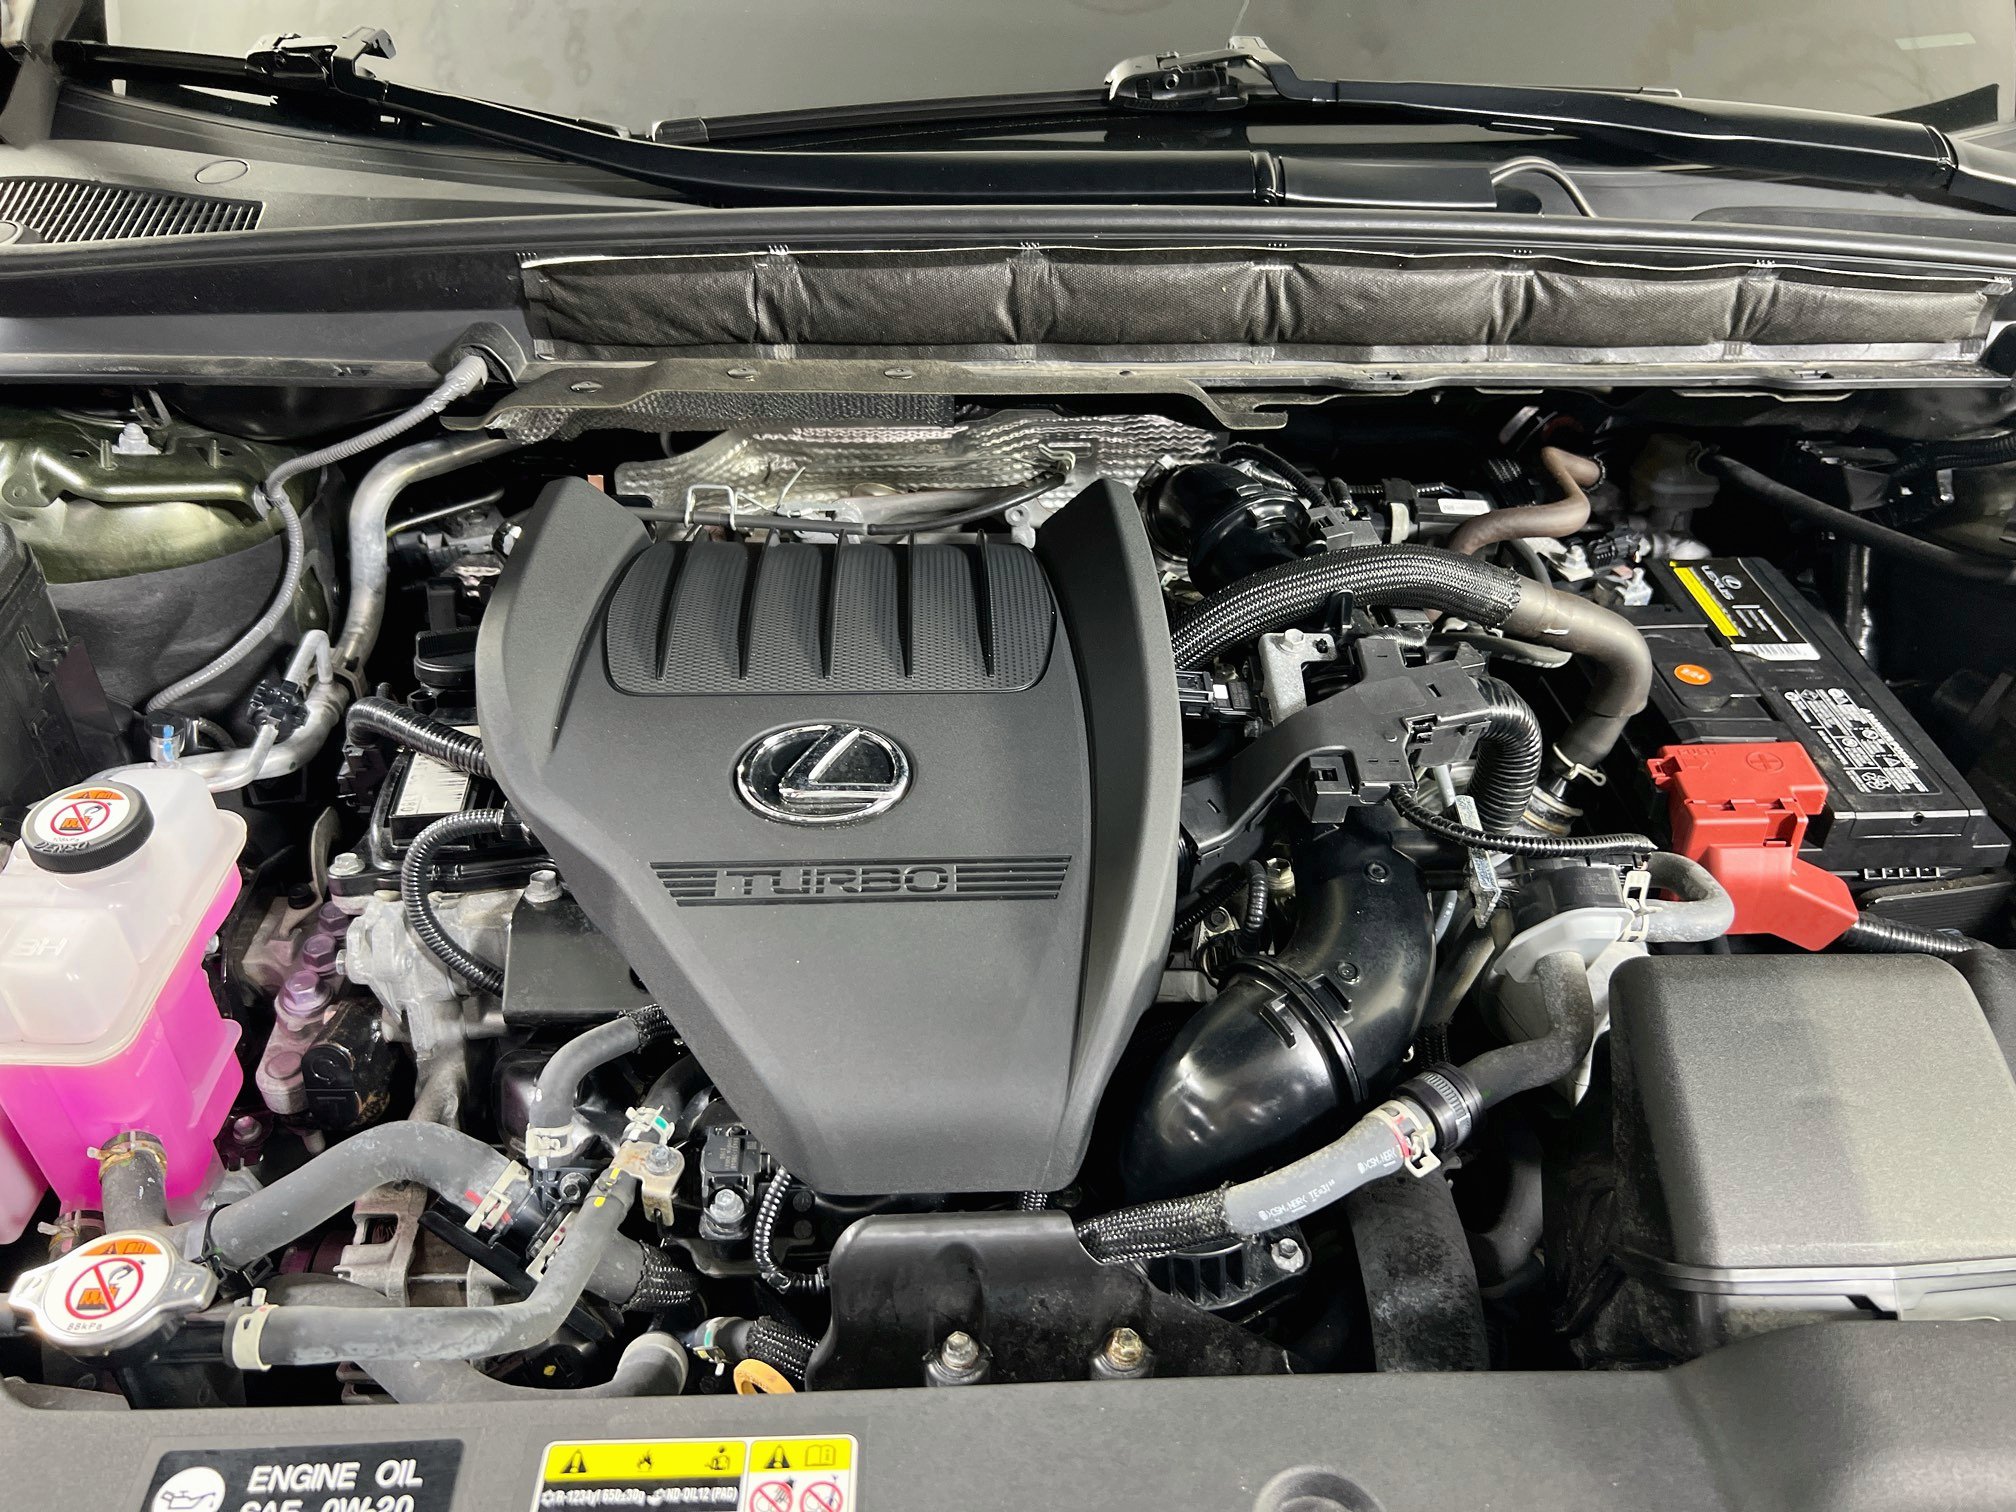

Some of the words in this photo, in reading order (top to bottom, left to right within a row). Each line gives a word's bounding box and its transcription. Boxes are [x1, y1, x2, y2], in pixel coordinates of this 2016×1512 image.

[1701, 565, 1735, 600] LEXUS
[33, 841, 90, 854] DENSO
[723, 864, 949, 896] TURBO
[247, 1462, 361, 1493] ENGINE
[375, 1459, 424, 1489] OIL
[601, 1488, 646, 1507] 650±30g
